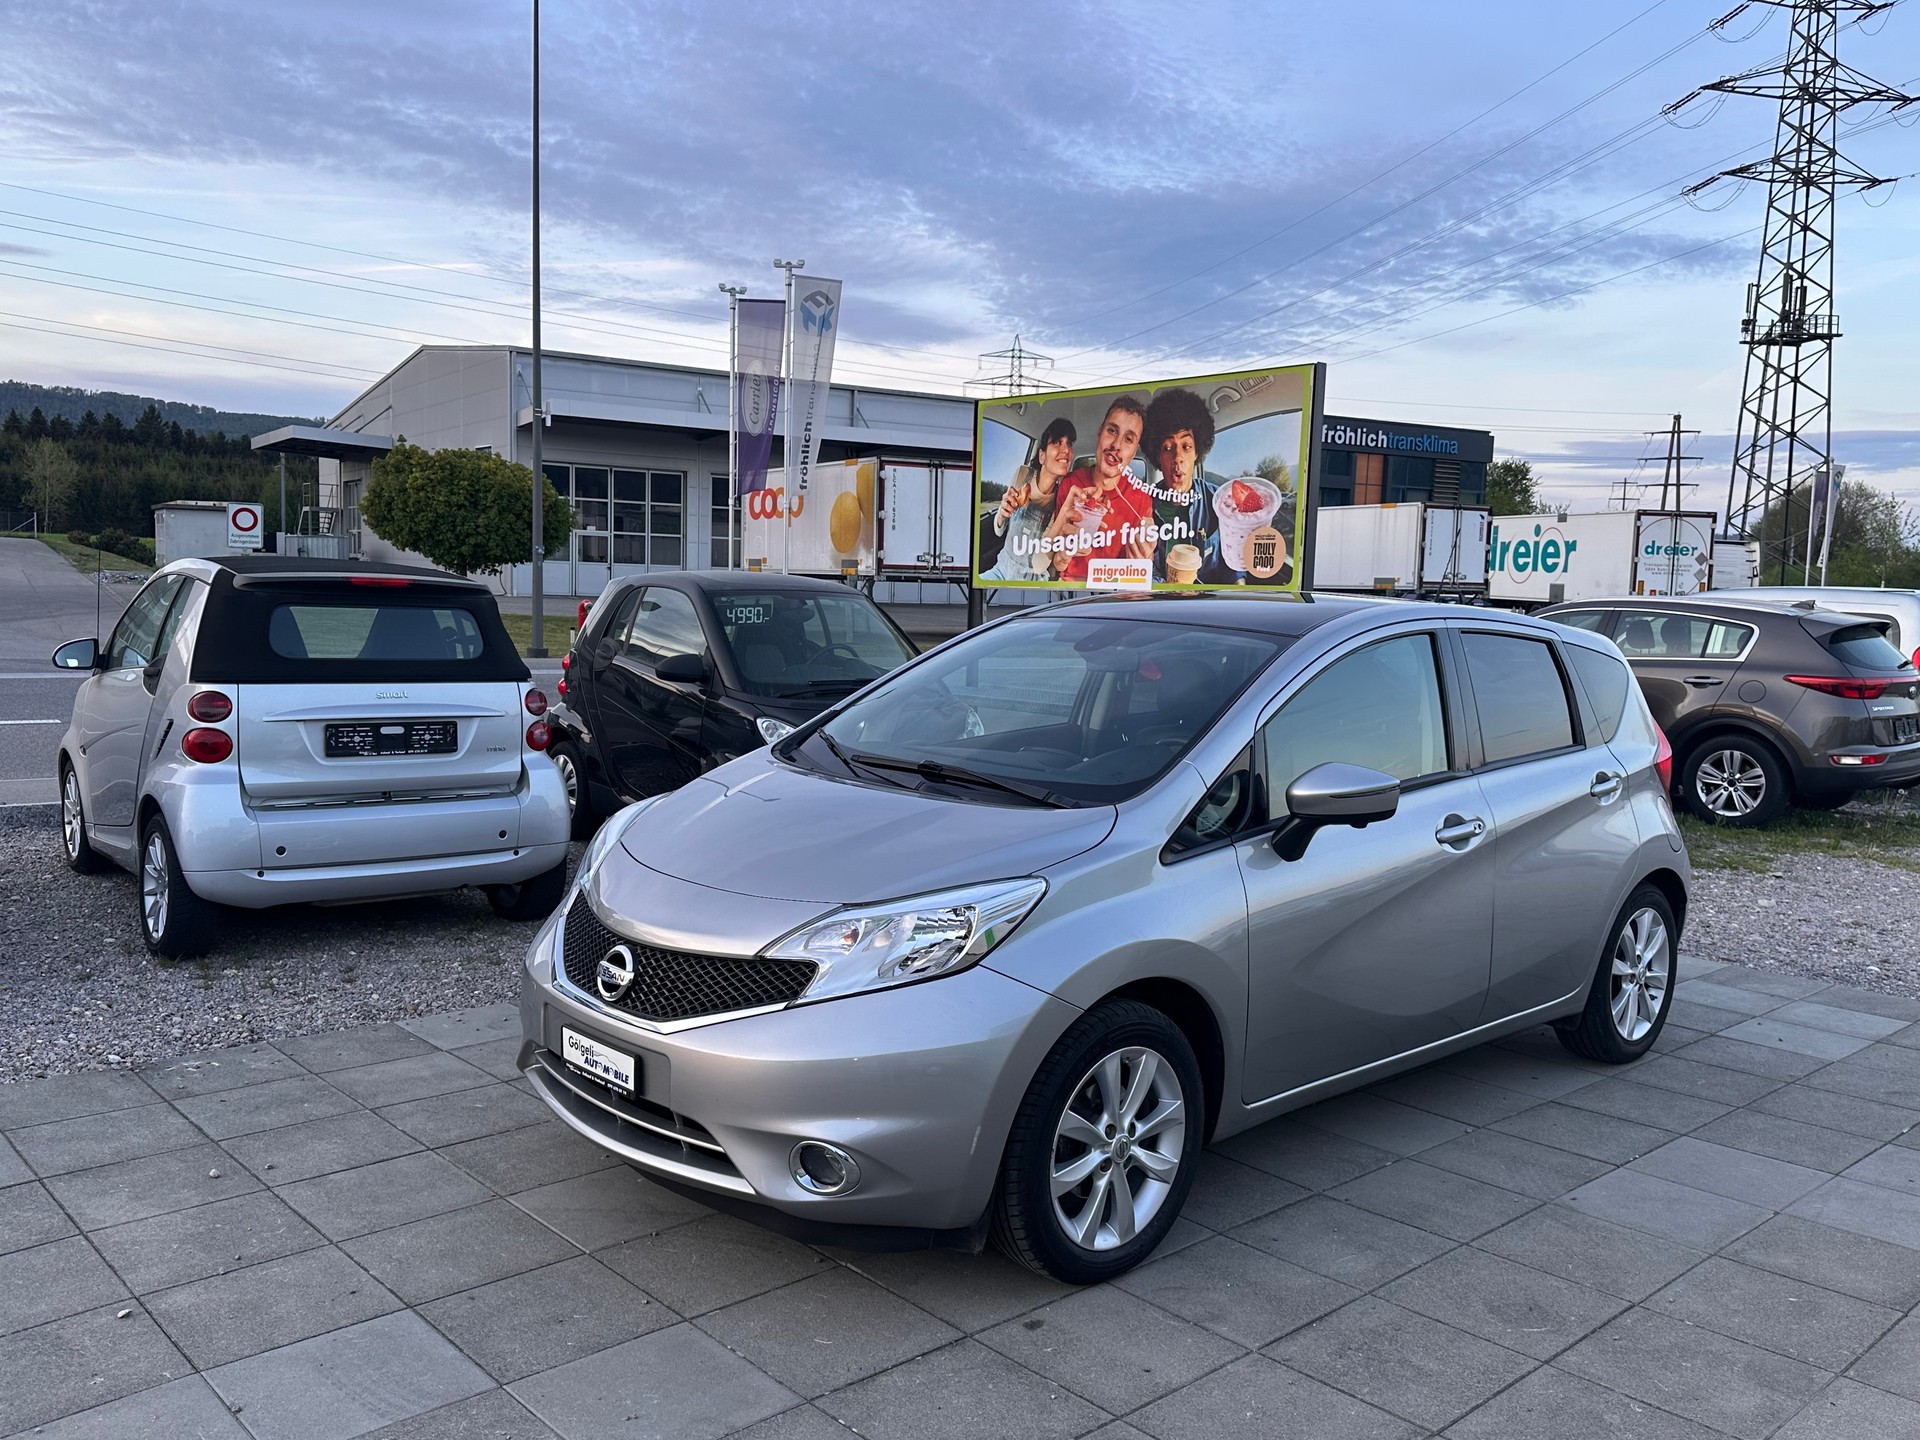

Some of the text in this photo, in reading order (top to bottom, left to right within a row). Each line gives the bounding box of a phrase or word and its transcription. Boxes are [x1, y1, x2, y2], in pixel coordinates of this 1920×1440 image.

[749, 370, 761, 425] Carrier
[749, 486, 804, 527] coop
[1012, 516, 1195, 556] Unsagbar frisch.
[1253, 543, 1276, 555] TRULY
[1644, 540, 1698, 556] dreier
[1253, 556, 1274, 568] GOOD
[1093, 564, 1147, 579] migrolino
[376, 690, 408, 699] smart
[568, 1036, 594, 1057] Gölgeli
